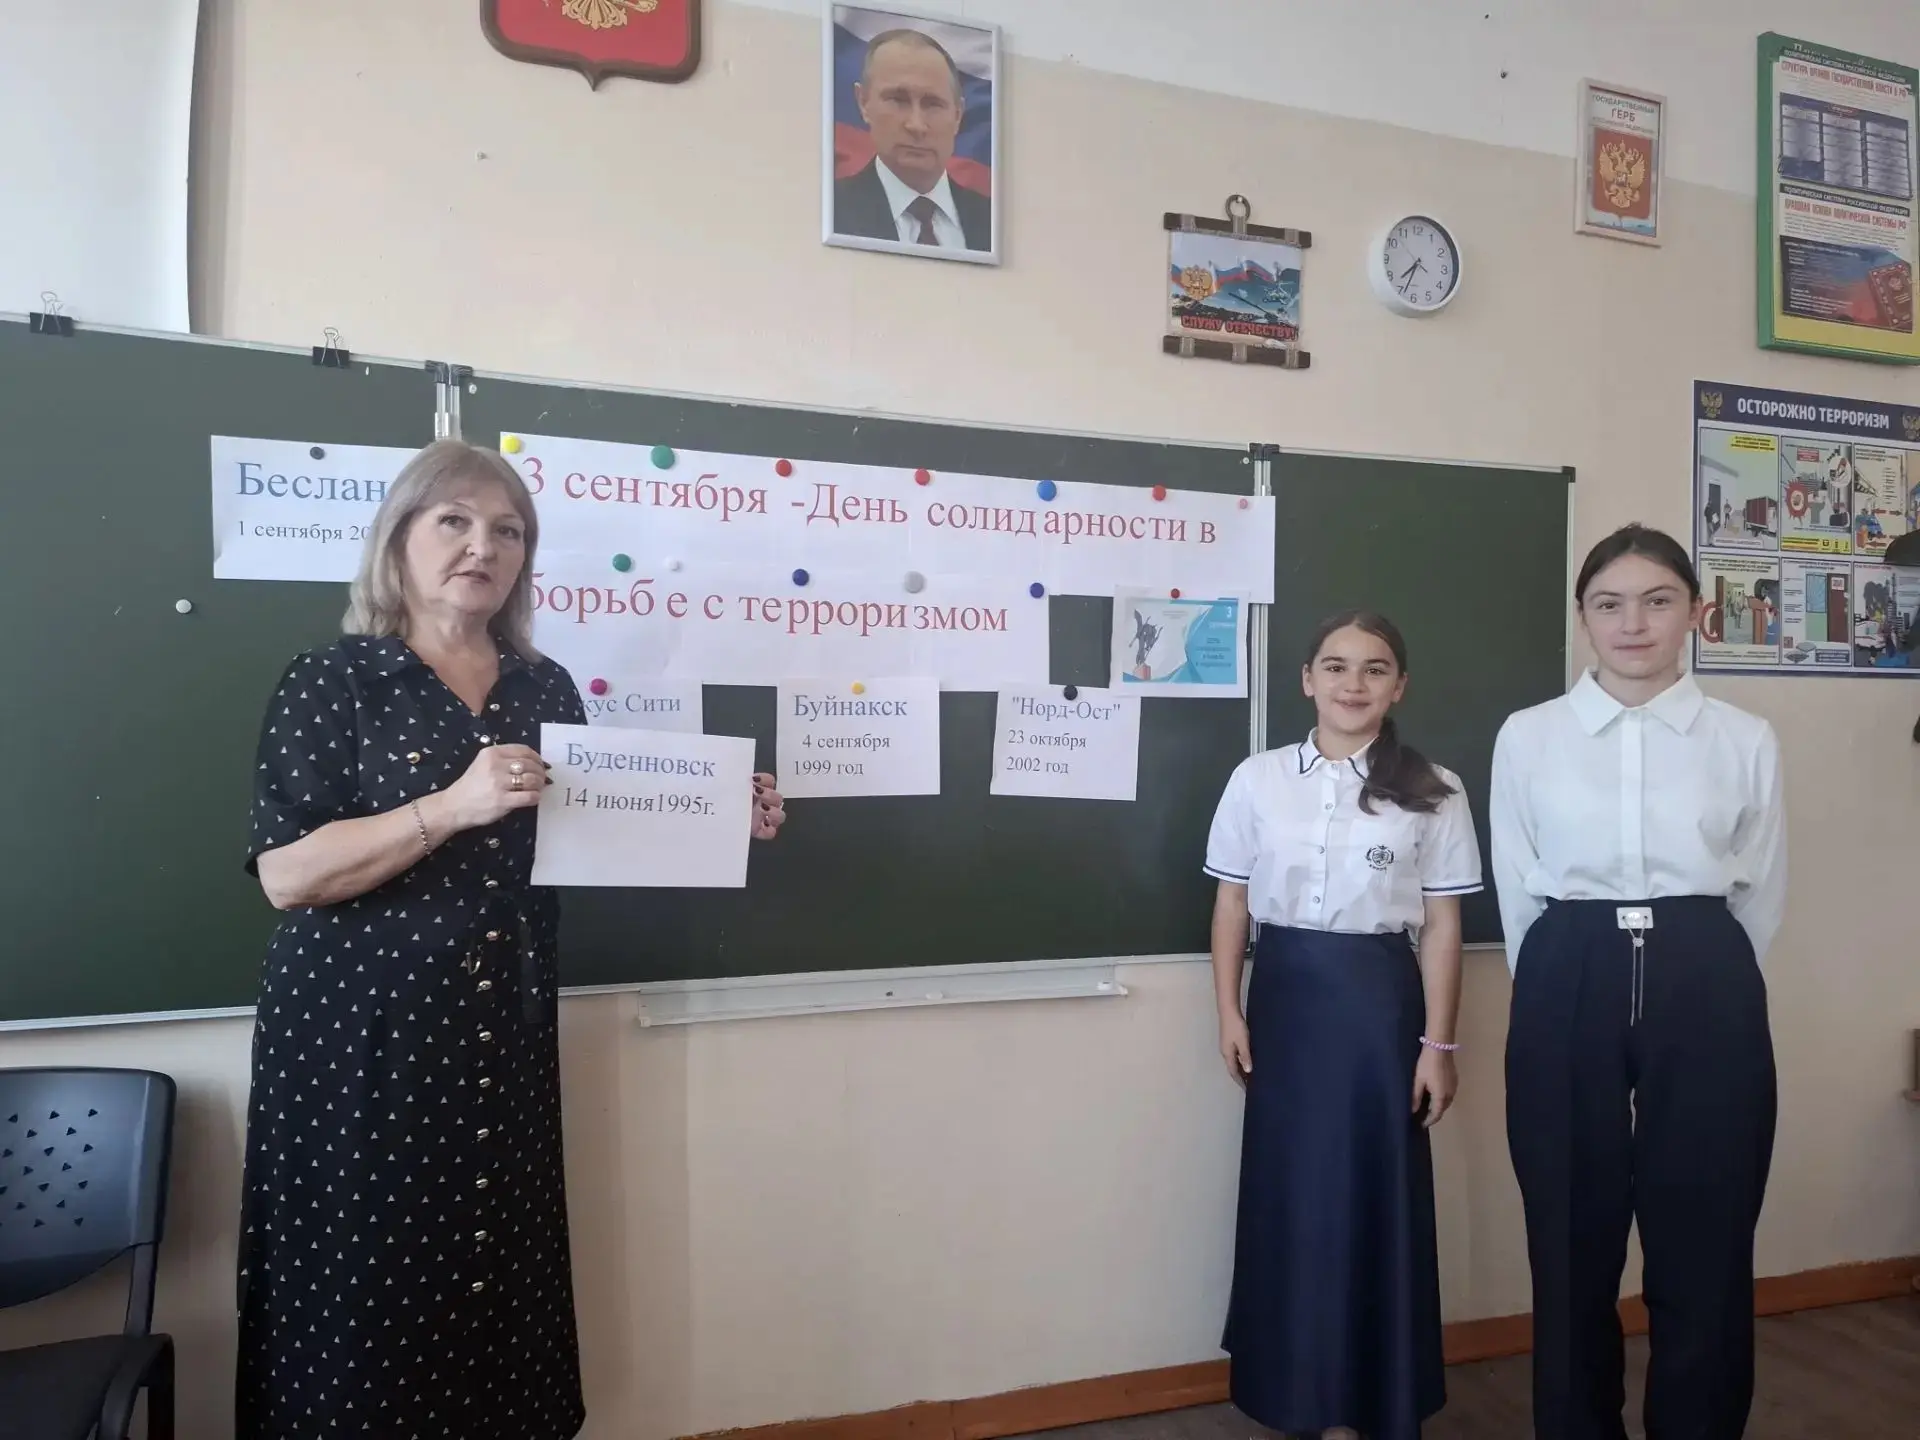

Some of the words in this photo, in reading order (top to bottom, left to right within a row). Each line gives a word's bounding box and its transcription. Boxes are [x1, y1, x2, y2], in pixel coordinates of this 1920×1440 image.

[1611, 107, 1636, 122] ГЕРБ
[1399, 227, 1408, 240] 11
[1412, 225, 1424, 236] 12
[1387, 237, 1398, 249] 10
[1437, 247, 1445, 258] 2
[1383, 253, 1390, 265] 9
[1387, 270, 1394, 282] 8
[1440, 264, 1448, 275] 3
[1396, 285, 1405, 295] 7
[1435, 280, 1443, 291] 4
[1410, 293, 1417, 304] 6
[1425, 291, 1432, 301] 5
[1181, 314, 1222, 331] СЛУЖУ
[1224, 320, 1297, 341] ОТЕЧЕСТВУ!
[1737, 397, 1816, 421] ОСТОРОЖНО
[1818, 407, 1890, 430] ТЕРРОРИЗМ
[234, 462, 389, 502] Беслан
[521, 456, 544, 495] 3
[563, 472, 769, 522] сентября
[927, 502, 1187, 544] солидарности
[1200, 520, 1217, 544] в
[239, 520, 245, 536] 1
[254, 523, 344, 544] сентября
[349, 525, 371, 541] 20
[703, 593, 724, 620] с
[738, 594, 1009, 637] терроризмом
[584, 698, 617, 718] кус
[625, 693, 681, 713] Сити
[794, 694, 908, 722] Буйнакск
[1012, 696, 1121, 722] "Норд-Ост"
[802, 734, 812, 749] 4
[817, 733, 891, 752] сентября
[1008, 729, 1025, 744] 23
[1030, 733, 1088, 750] октября
[565, 742, 716, 777] Буденновск
[794, 760, 832, 776] 1999
[837, 763, 864, 776] год
[1006, 756, 1041, 772] 2002
[1045, 762, 1069, 775] год
[564, 786, 588, 808] 14
